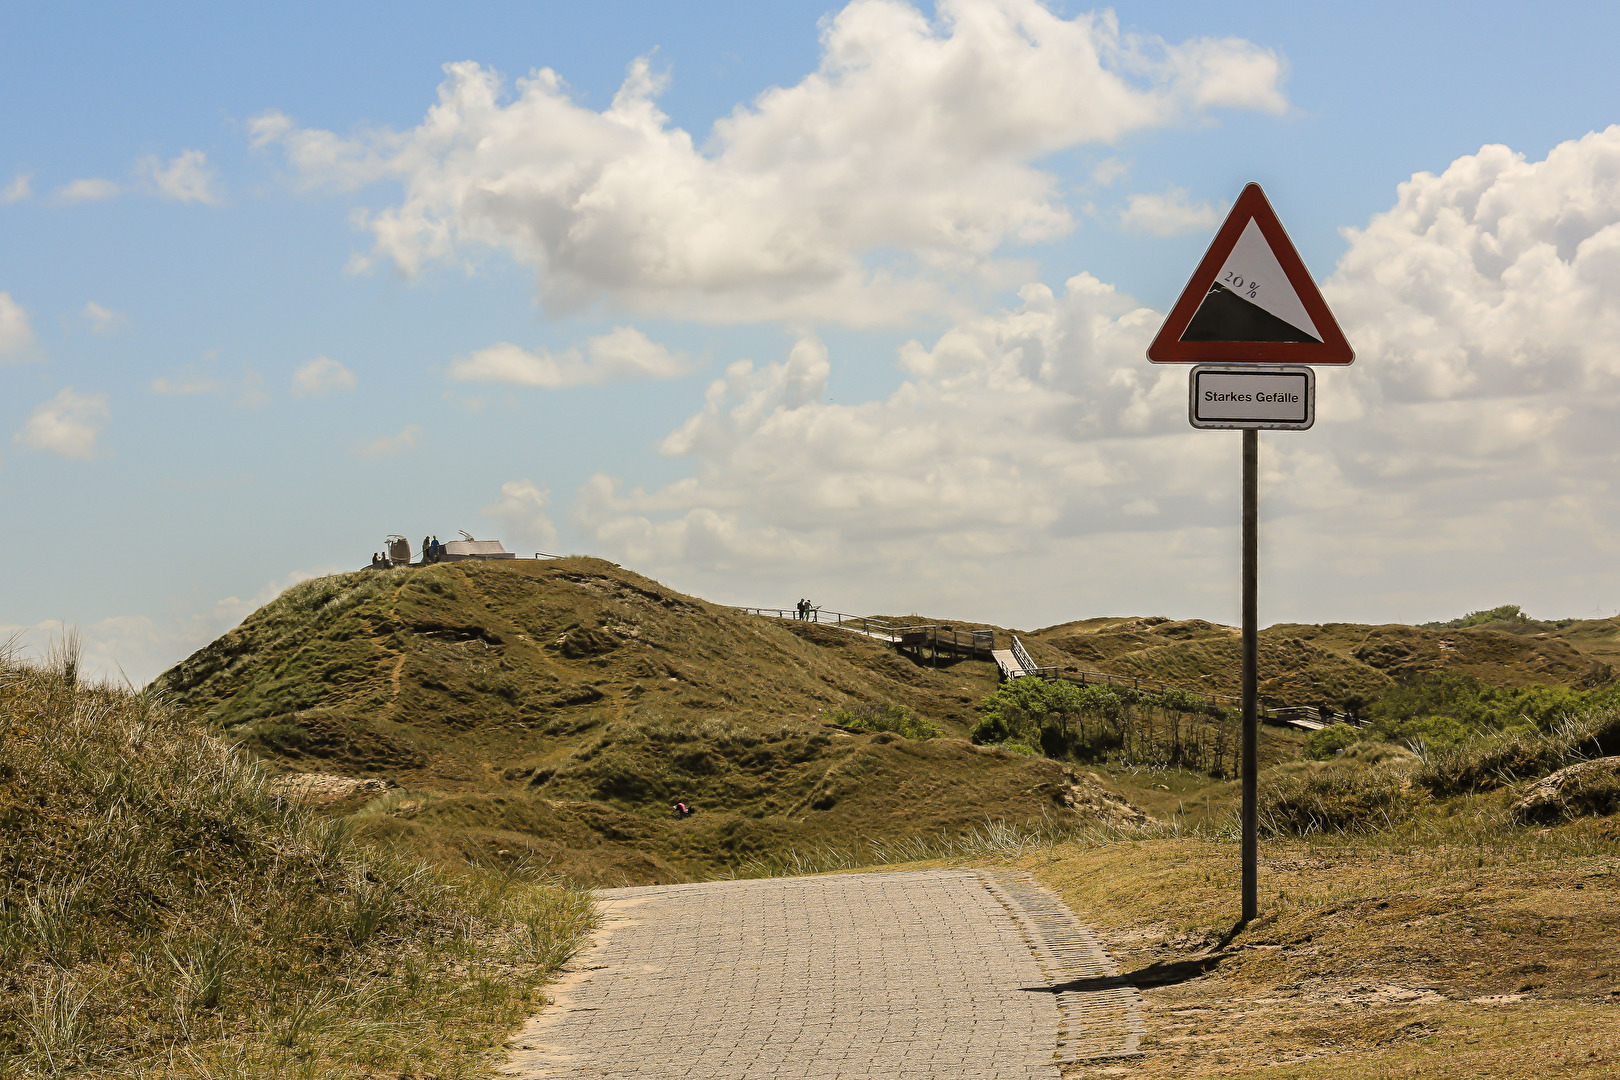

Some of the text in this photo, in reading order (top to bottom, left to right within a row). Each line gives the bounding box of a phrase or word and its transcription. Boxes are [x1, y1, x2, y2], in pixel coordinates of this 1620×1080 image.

[1224, 271, 1244, 288] 20
[1204, 391, 1299, 403] Starkes Gefälle
